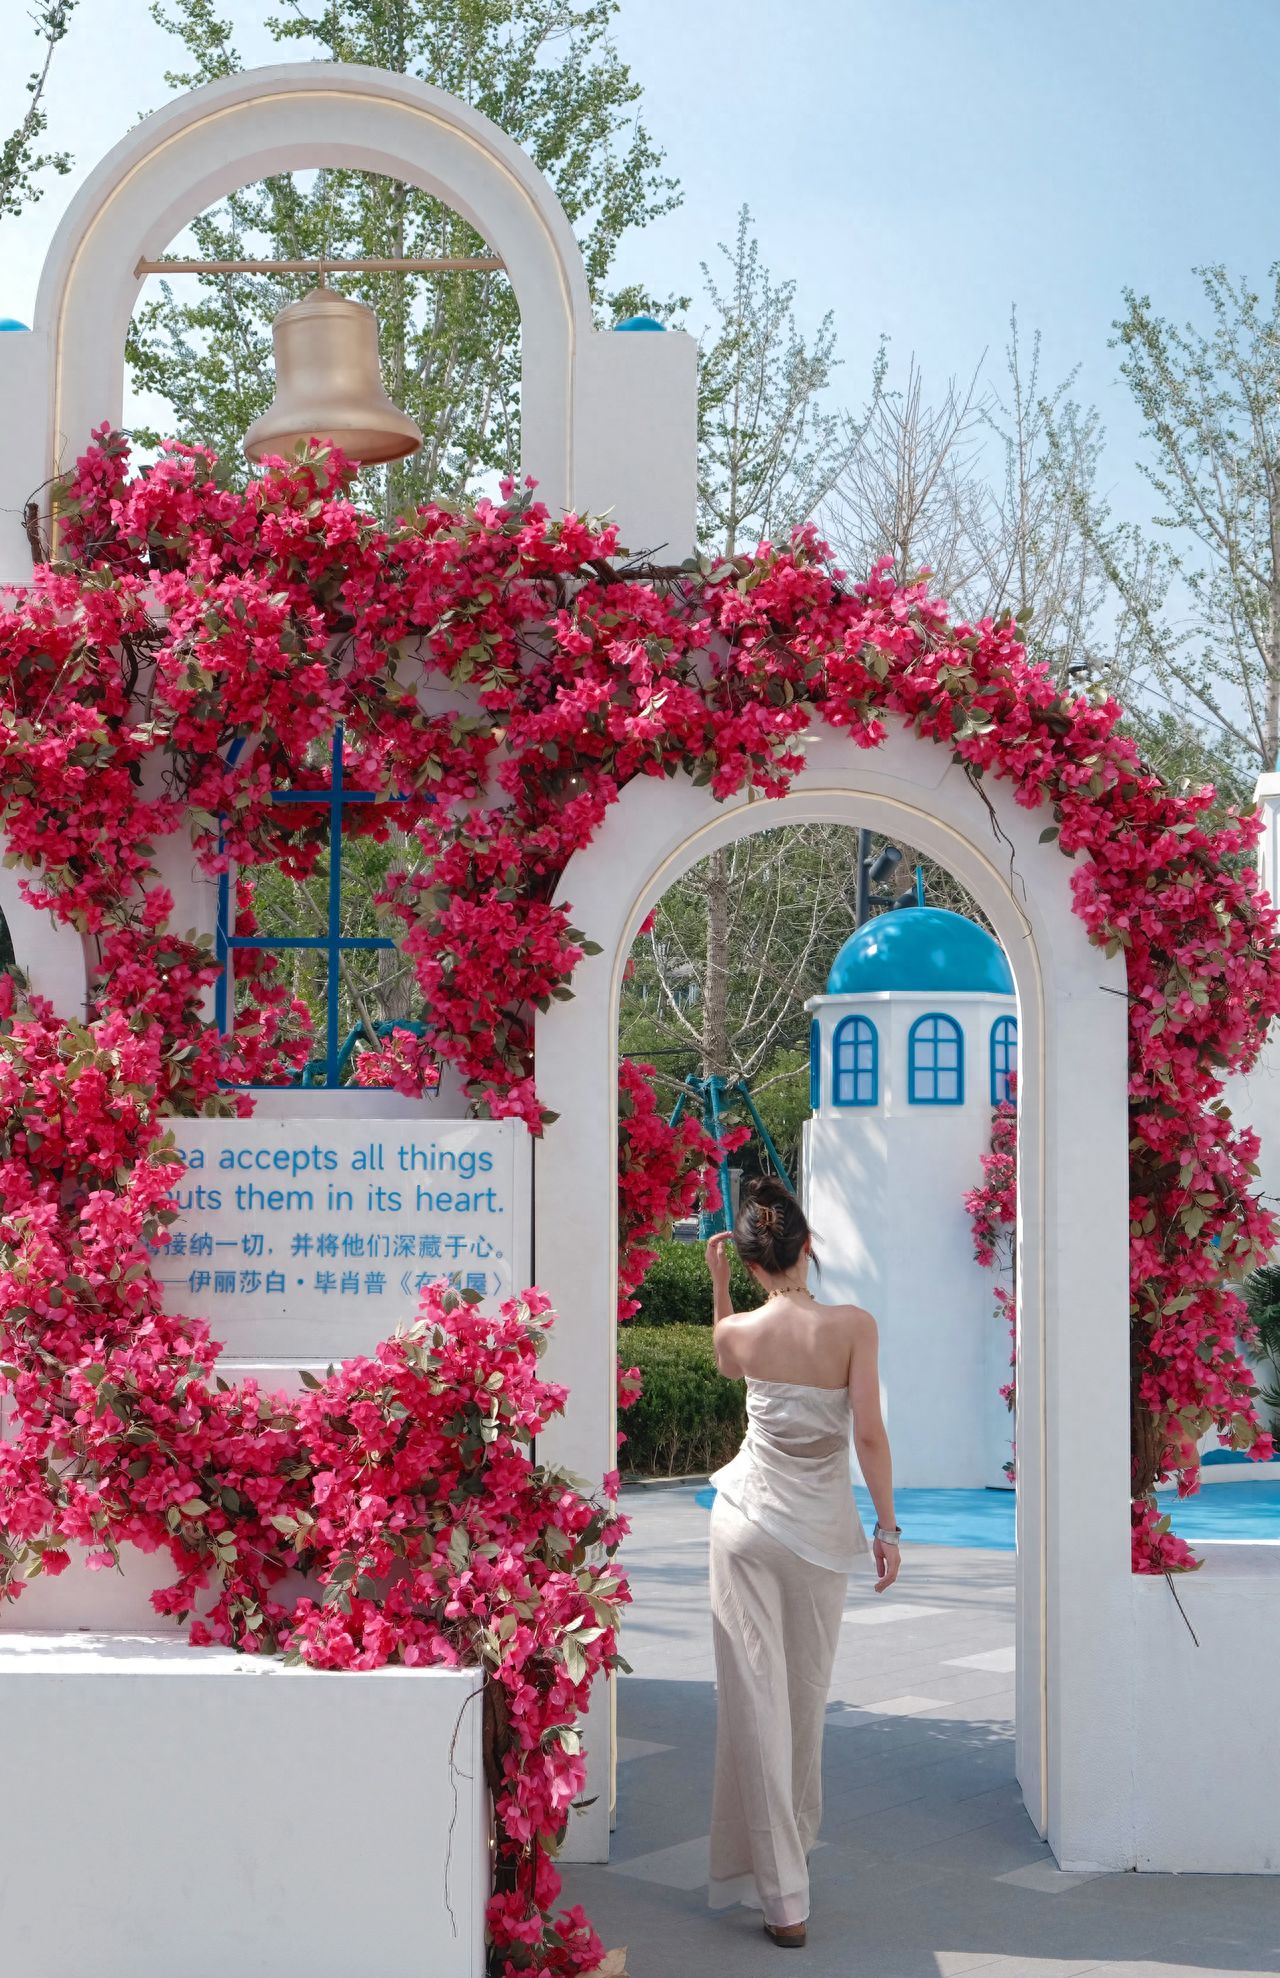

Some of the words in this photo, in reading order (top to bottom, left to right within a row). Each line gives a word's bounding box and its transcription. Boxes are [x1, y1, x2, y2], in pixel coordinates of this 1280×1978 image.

[219, 1145, 338, 1177] accepts
[351, 1143, 385, 1171] all
[398, 1143, 494, 1180] things
[165, 1184, 222, 1210] uts
[235, 1183, 314, 1211] them
[328, 1184, 353, 1211] in
[368, 1184, 402, 1212] its
[416, 1184, 504, 1213] heart.
